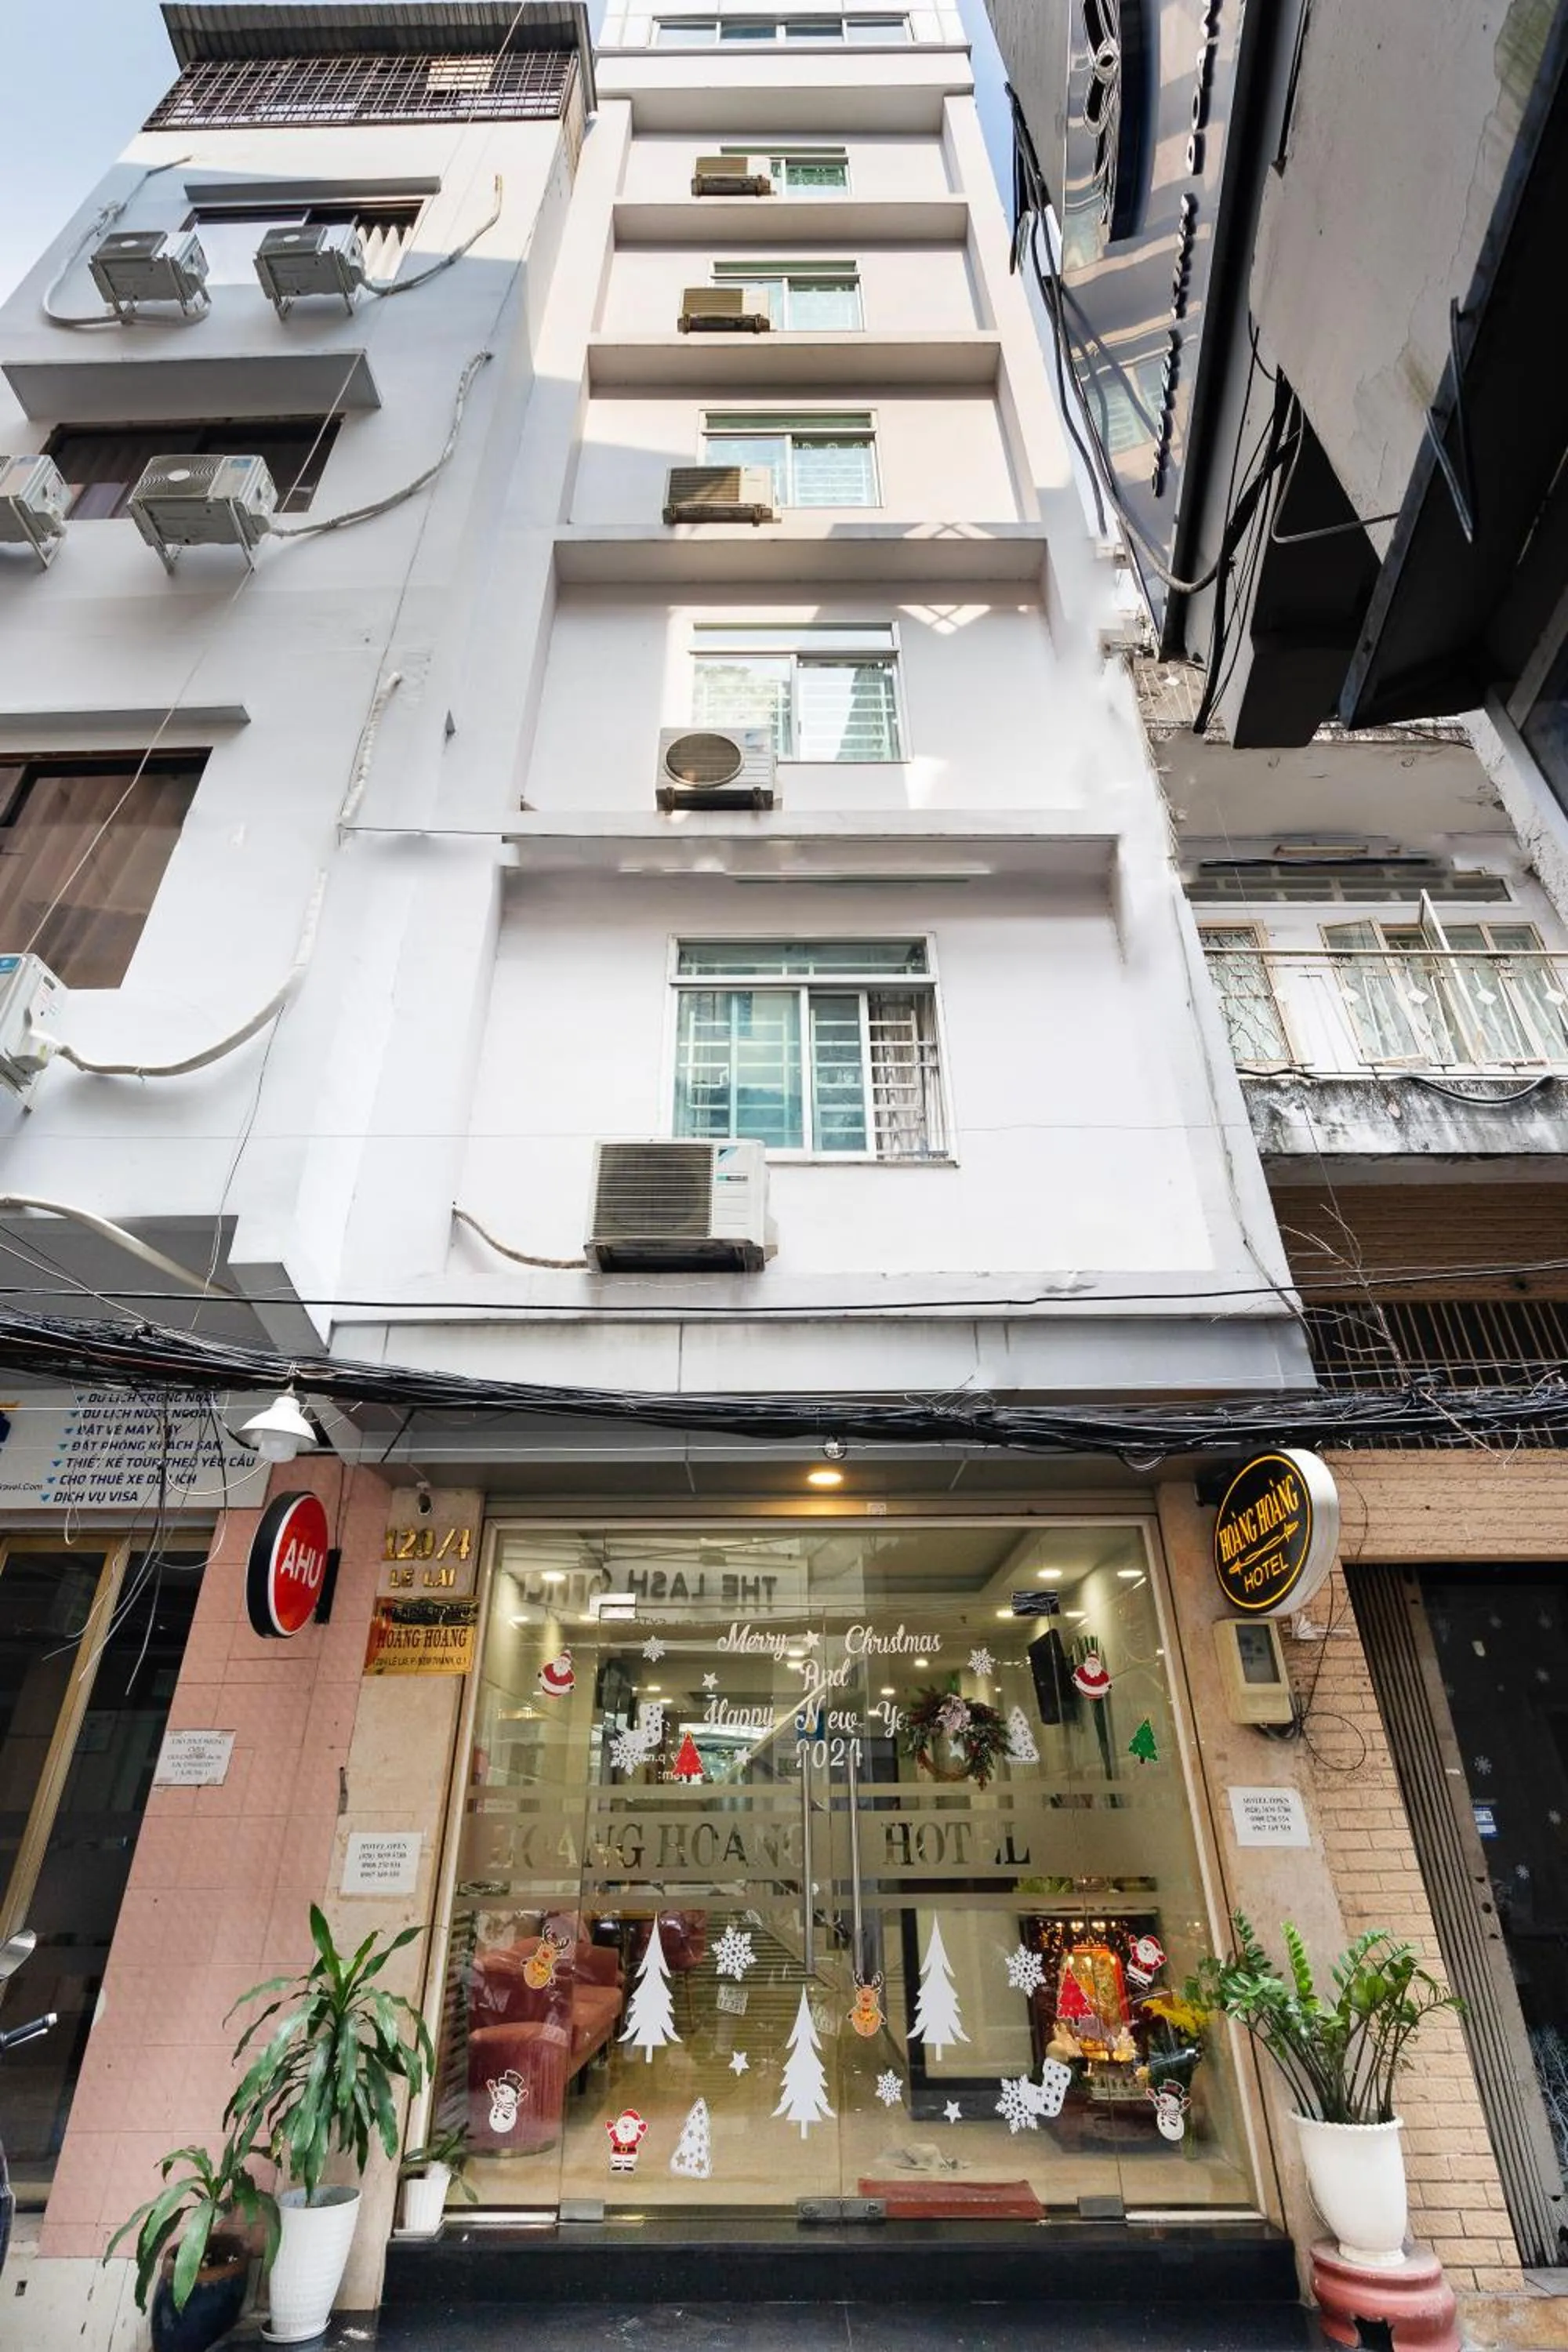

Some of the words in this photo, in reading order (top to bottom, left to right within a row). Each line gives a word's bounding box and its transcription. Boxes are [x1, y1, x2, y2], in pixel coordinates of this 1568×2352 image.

[60, 1474, 87, 1486] CHO
[89, 1472, 125, 1485] THUÊ
[126, 1474, 145, 1485] XE
[111, 1491, 139, 1503] VISA
[382, 1528, 471, 1561] 120/4
[280, 1537, 324, 1589] AHU
[1244, 1552, 1290, 1594] HOTEL
[717, 1622, 789, 1661] Merry
[844, 1623, 943, 1655] Christmas
[704, 1697, 776, 1730] Happy
[880, 1820, 1032, 1866] HOTEL
